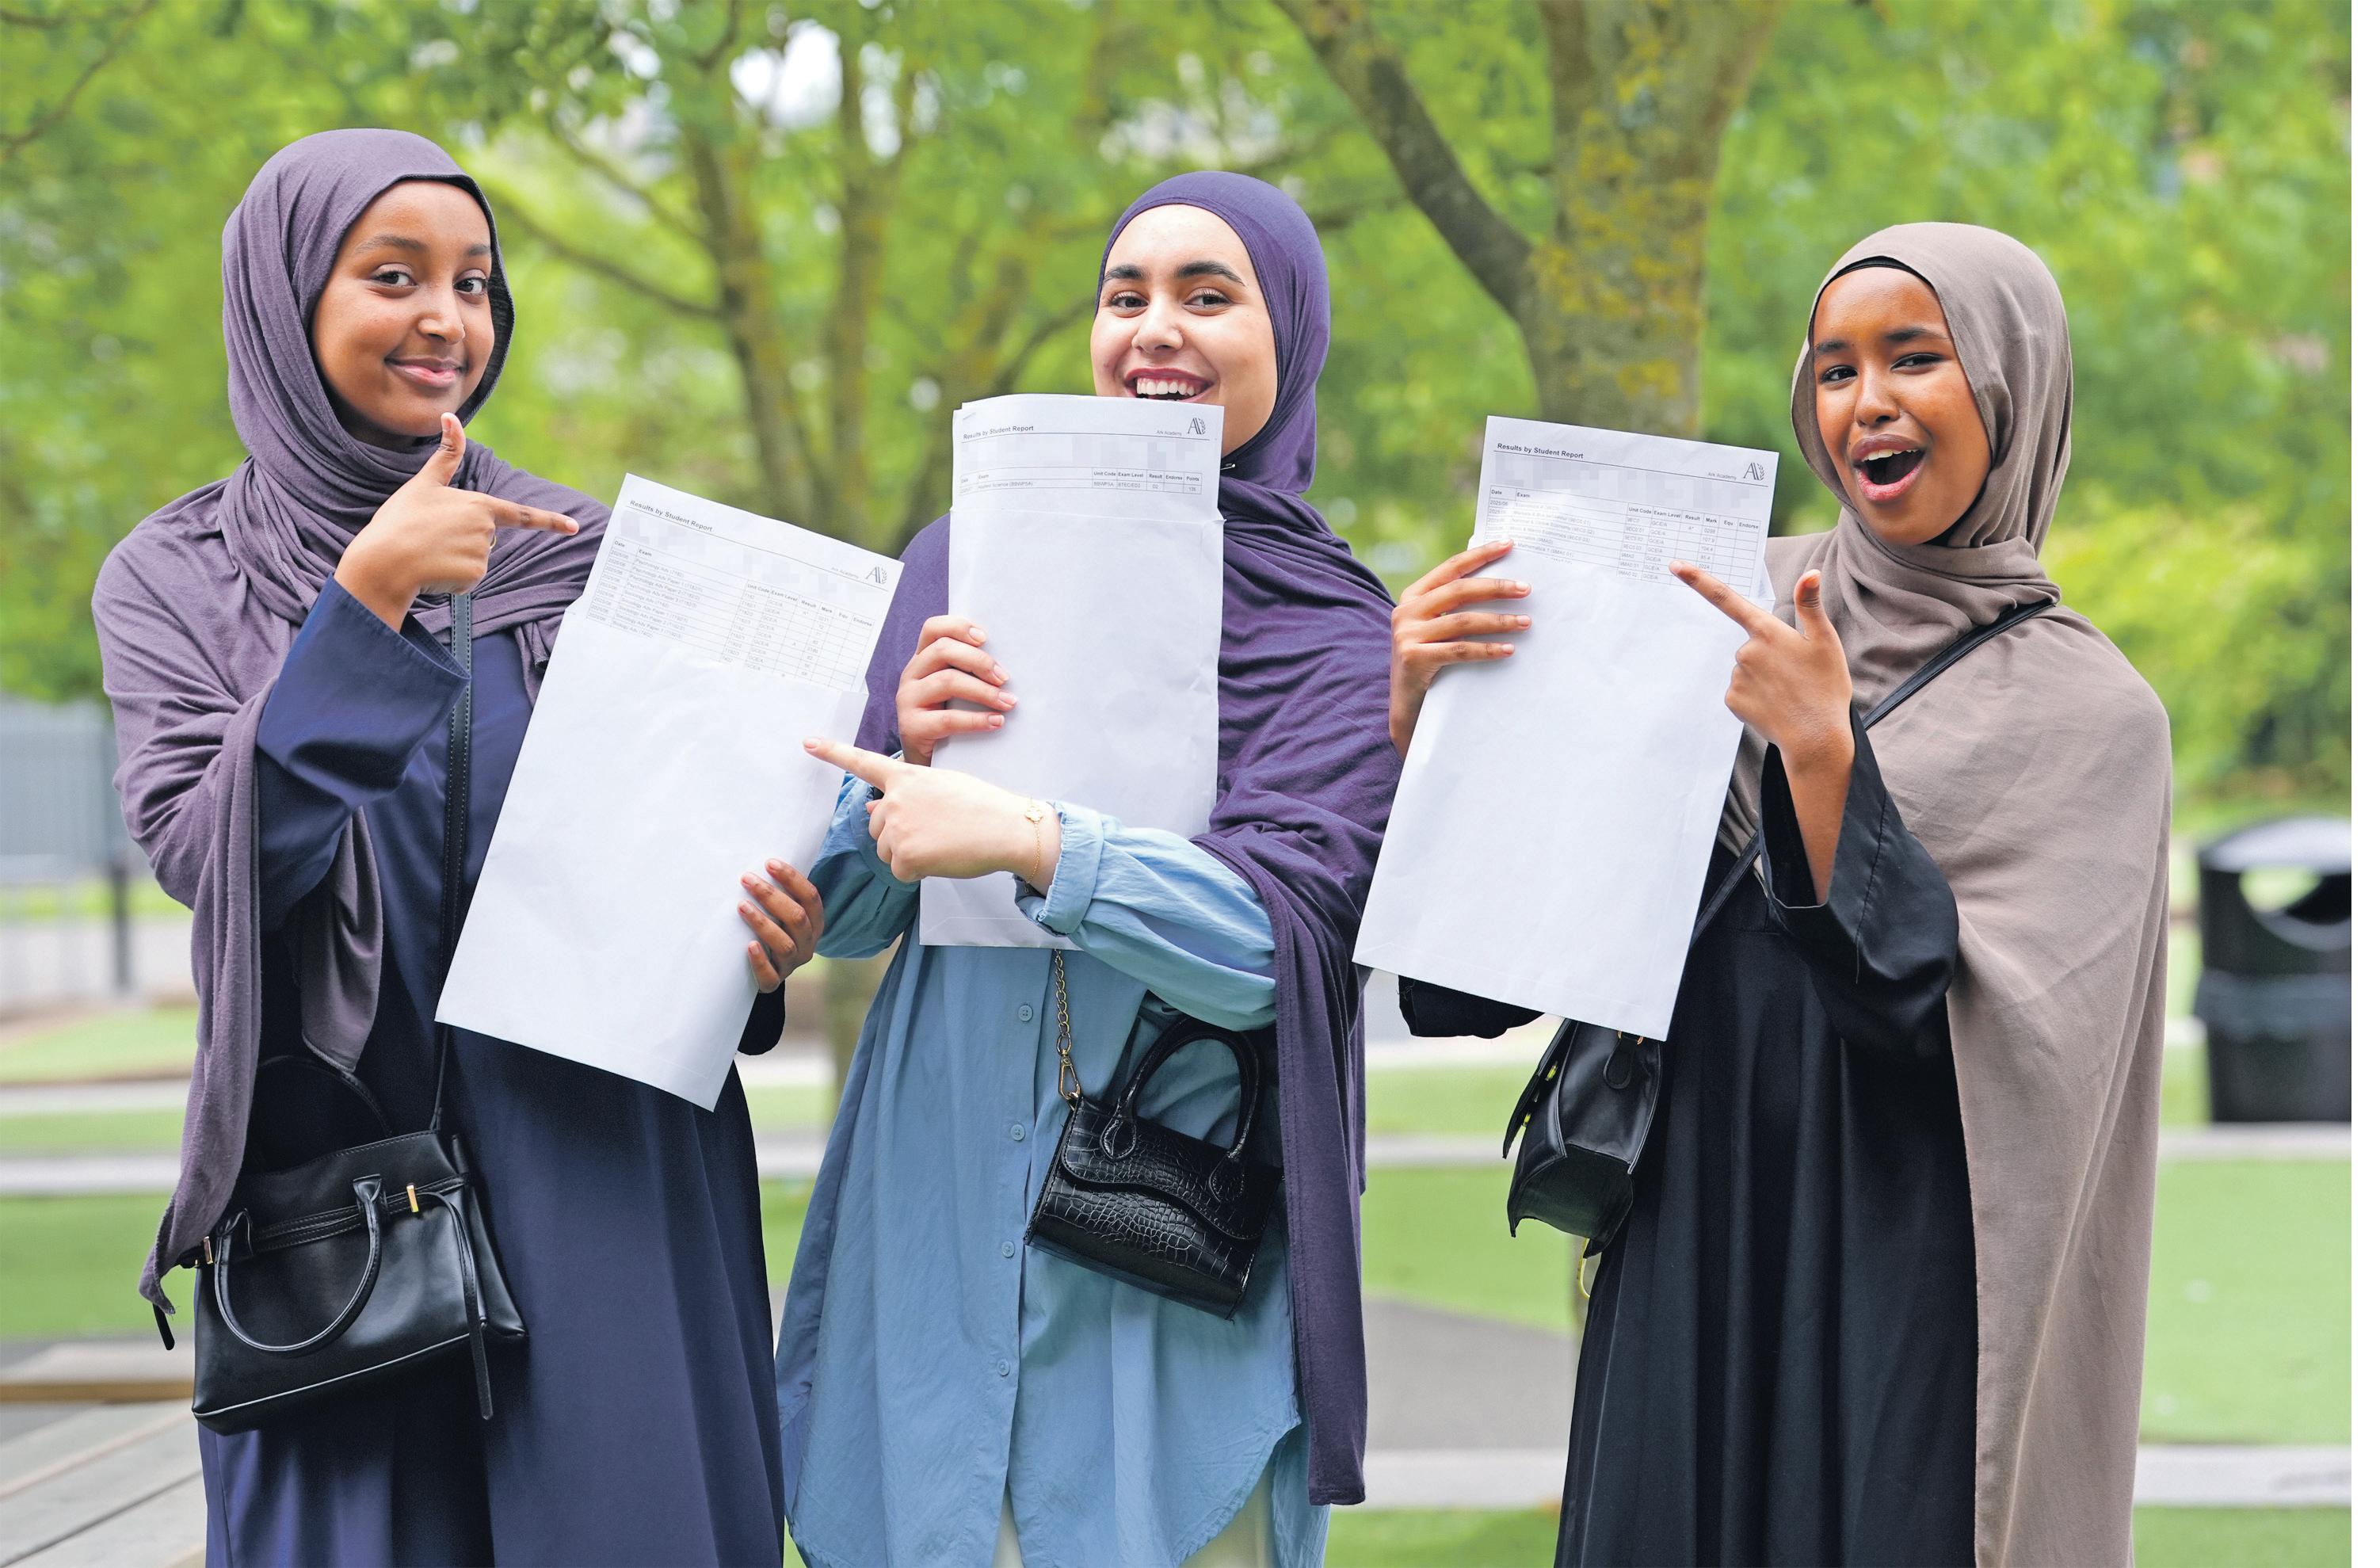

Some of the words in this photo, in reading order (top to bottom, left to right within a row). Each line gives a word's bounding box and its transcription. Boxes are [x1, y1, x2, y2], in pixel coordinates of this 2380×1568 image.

[1497, 443, 1522, 452] Results
[1534, 448, 1559, 456] Student
[1561, 451, 1584, 460] Report
[630, 500, 654, 513] Results
[665, 512, 690, 525] Student
[690, 521, 712, 532] Report
[771, 590, 785, 599] Exam
[801, 600, 817, 609] Result
